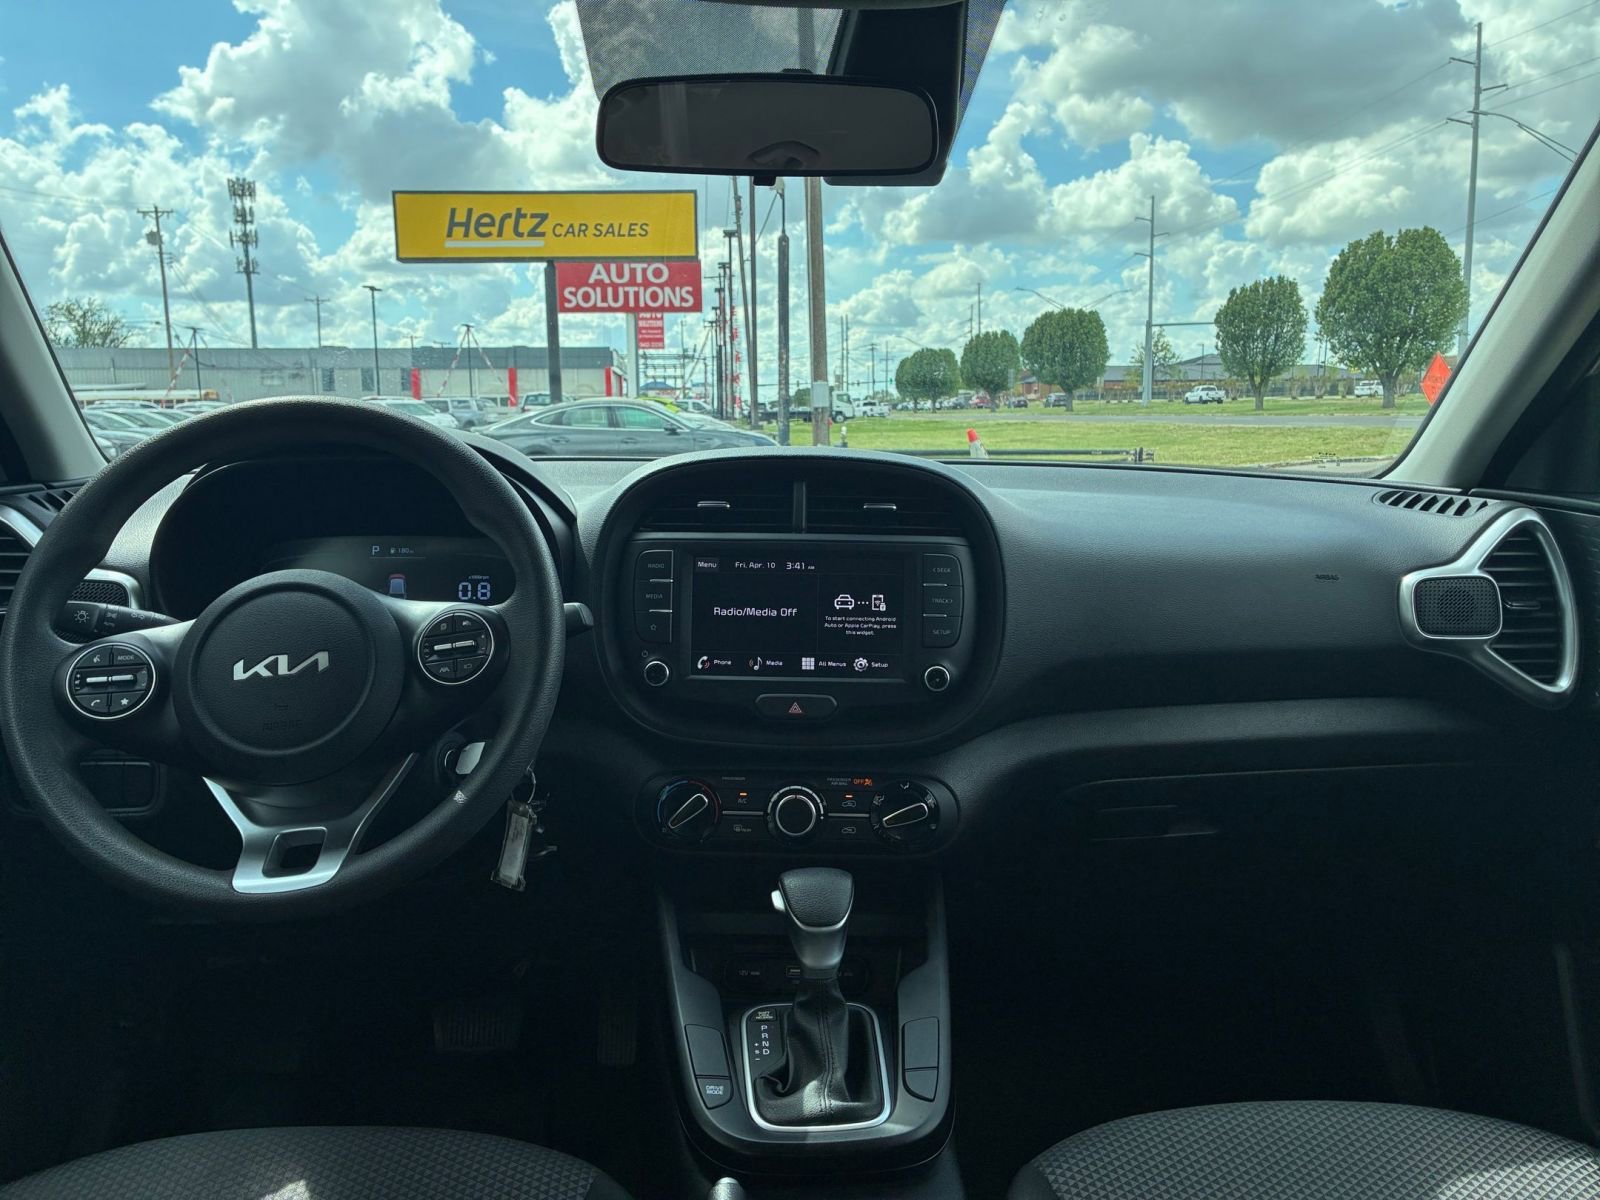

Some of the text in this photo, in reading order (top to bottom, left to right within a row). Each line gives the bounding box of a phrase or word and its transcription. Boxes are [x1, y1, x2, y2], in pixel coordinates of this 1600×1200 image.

[446, 207, 650, 238] Hertz CAR SALES
[588, 262, 670, 284] AUTO
[563, 286, 694, 309] SOLUTIONS
[372, 545, 380, 555] P
[767, 561, 776, 569] 10
[786, 562, 805, 570] 3:41
[458, 582, 491, 601] 0.8
[713, 606, 798, 617] Radio/Media Off
